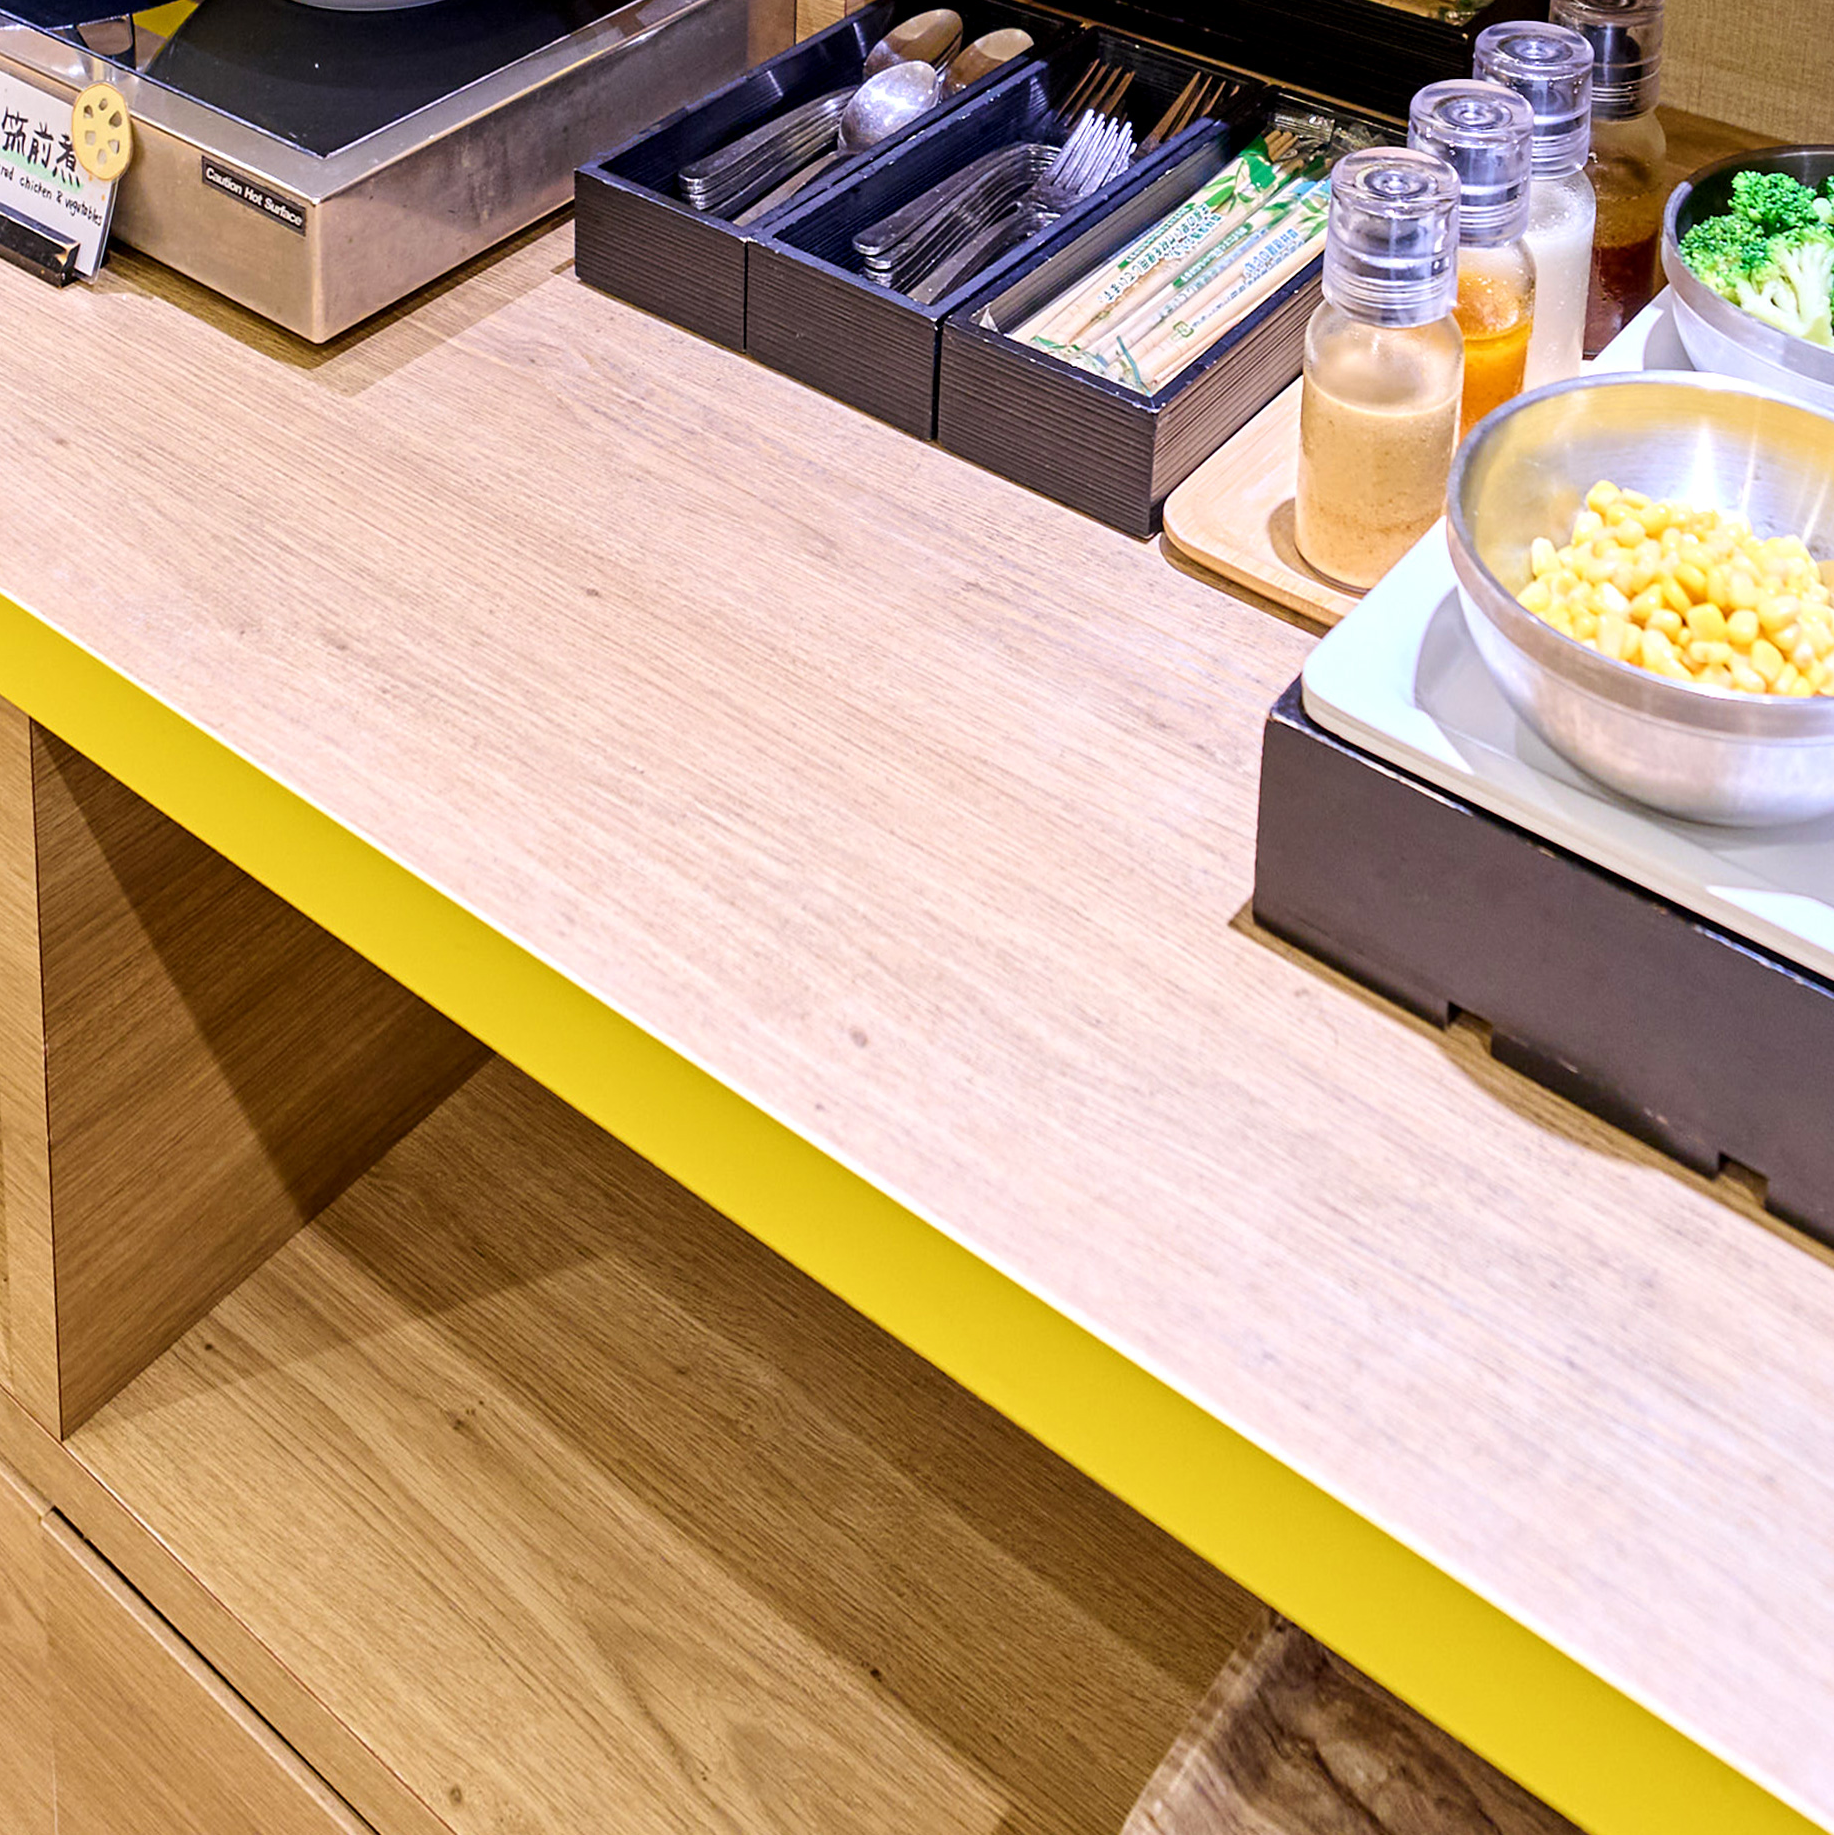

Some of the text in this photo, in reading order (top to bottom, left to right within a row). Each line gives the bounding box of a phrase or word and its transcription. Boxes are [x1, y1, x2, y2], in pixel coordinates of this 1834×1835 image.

[0, 106, 82, 189] 筑前煮
[19, 173, 53, 200] chicken
[206, 167, 303, 226] Caution Hot Surface
